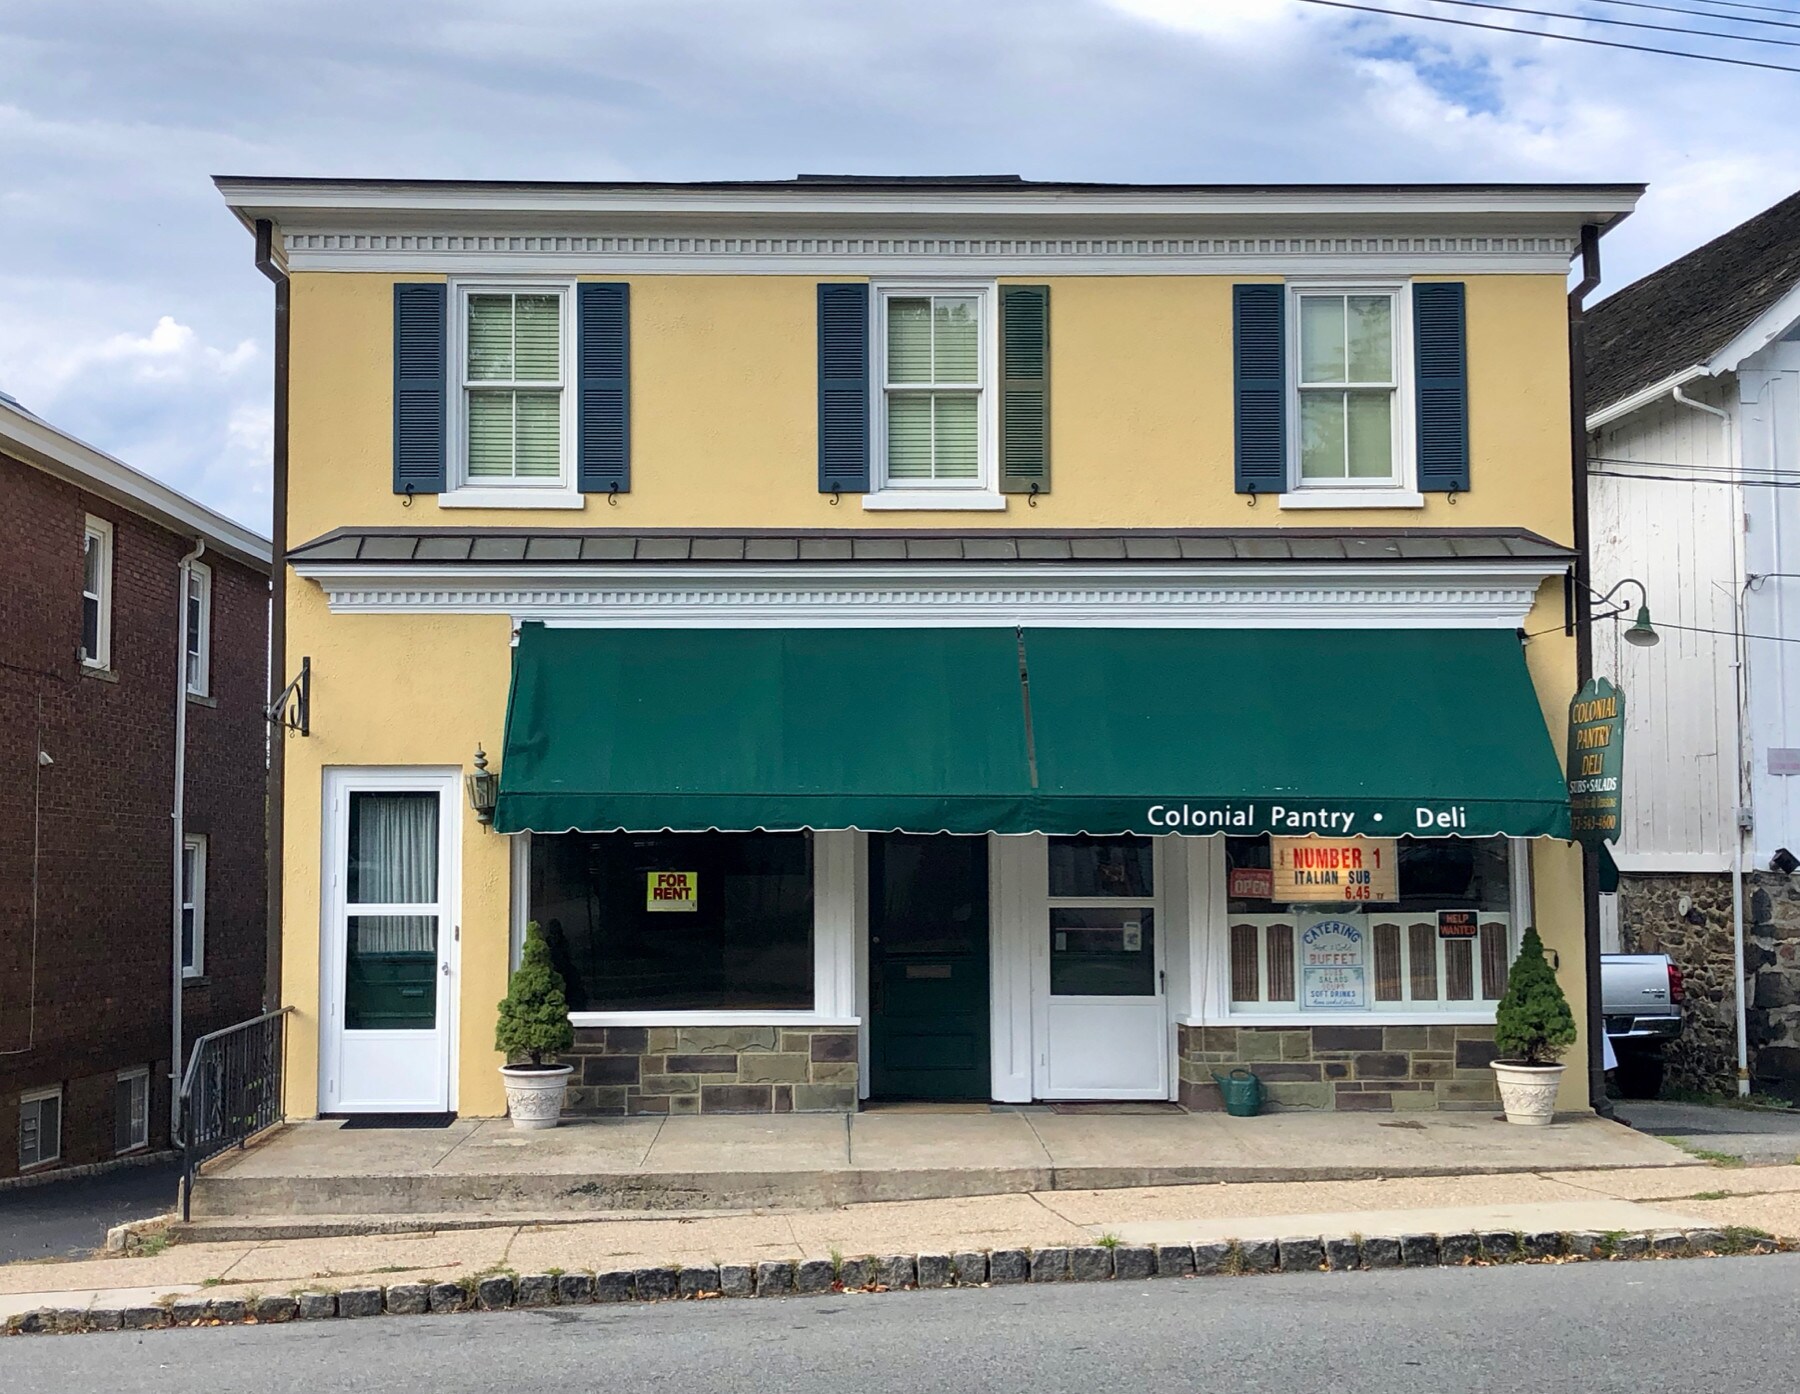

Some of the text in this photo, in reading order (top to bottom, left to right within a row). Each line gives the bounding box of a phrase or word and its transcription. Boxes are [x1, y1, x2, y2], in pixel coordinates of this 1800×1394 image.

[1573, 697, 1617, 724] COLONIAL
[1576, 724, 1612, 750] PANTRY
[1582, 753, 1603, 775] DELI
[1147, 803, 1466, 833] Colonial Pantry Deli
[1293, 847, 1362, 869] NUMBER
[1373, 847, 1381, 869] 1
[658, 874, 687, 887] FOR
[1294, 870, 1371, 885] ITALIAN SUB
[653, 887, 691, 900] RENT
[1235, 880, 1269, 895] OPEN
[1345, 886, 1370, 900] 6.45
[1446, 914, 1469, 923] HELP
[1304, 923, 1360, 944] CATERING
[1440, 924, 1476, 935] WANTED
[1309, 953, 1356, 965] BUFFET
[1310, 990, 1329, 998] SOFT
